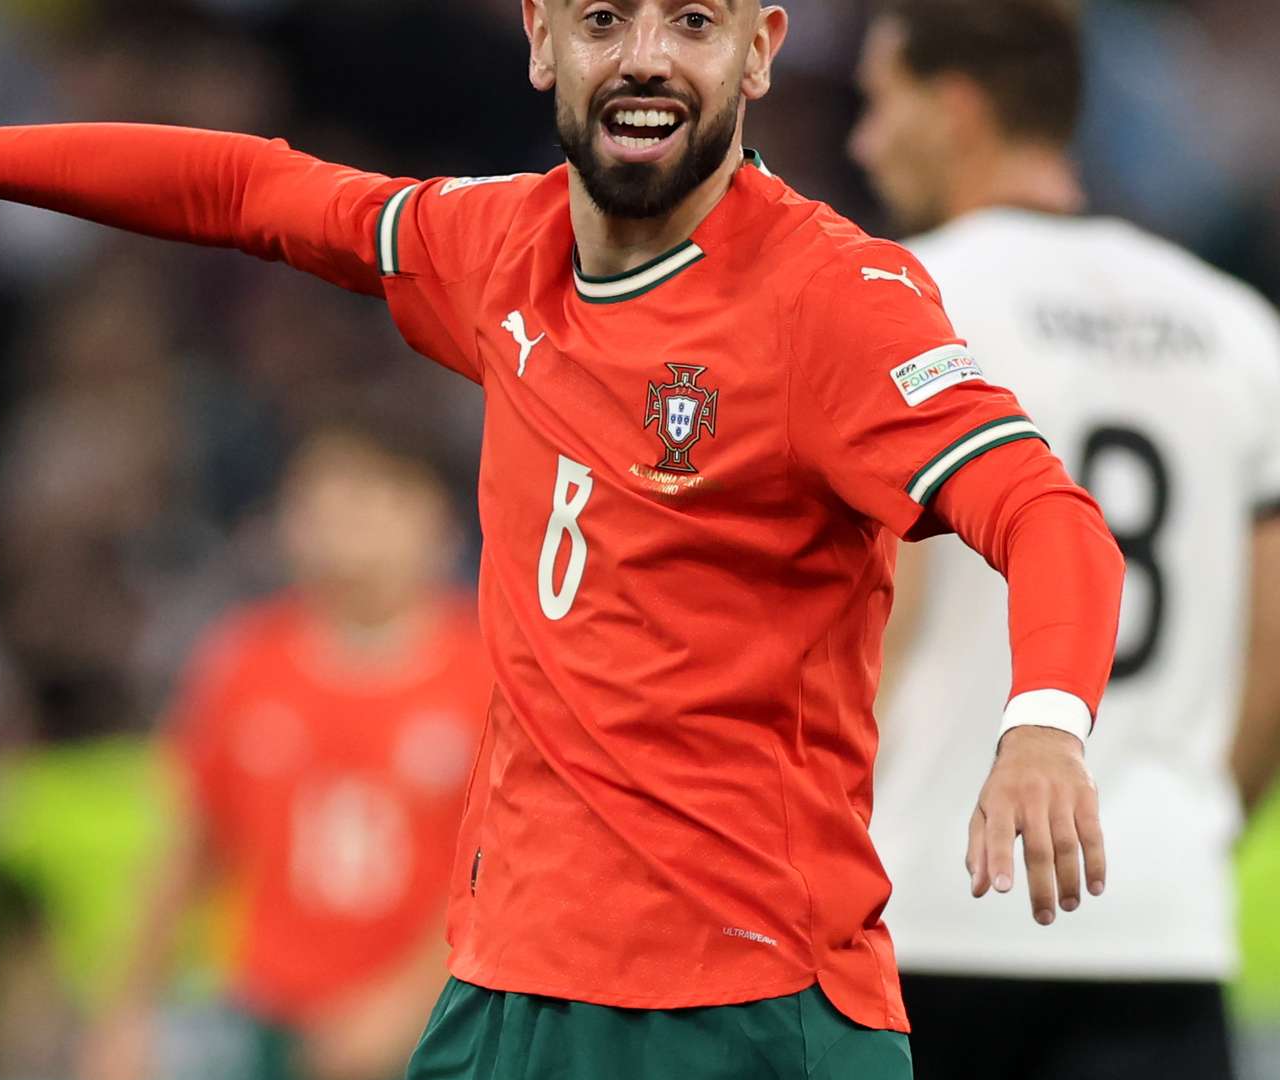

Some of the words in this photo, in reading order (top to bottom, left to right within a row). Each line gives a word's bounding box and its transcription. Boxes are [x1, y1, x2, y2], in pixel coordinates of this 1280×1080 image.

[895, 363, 918, 379] UEFA
[537, 453, 594, 621] 8
[1082, 424, 1169, 682] 8
